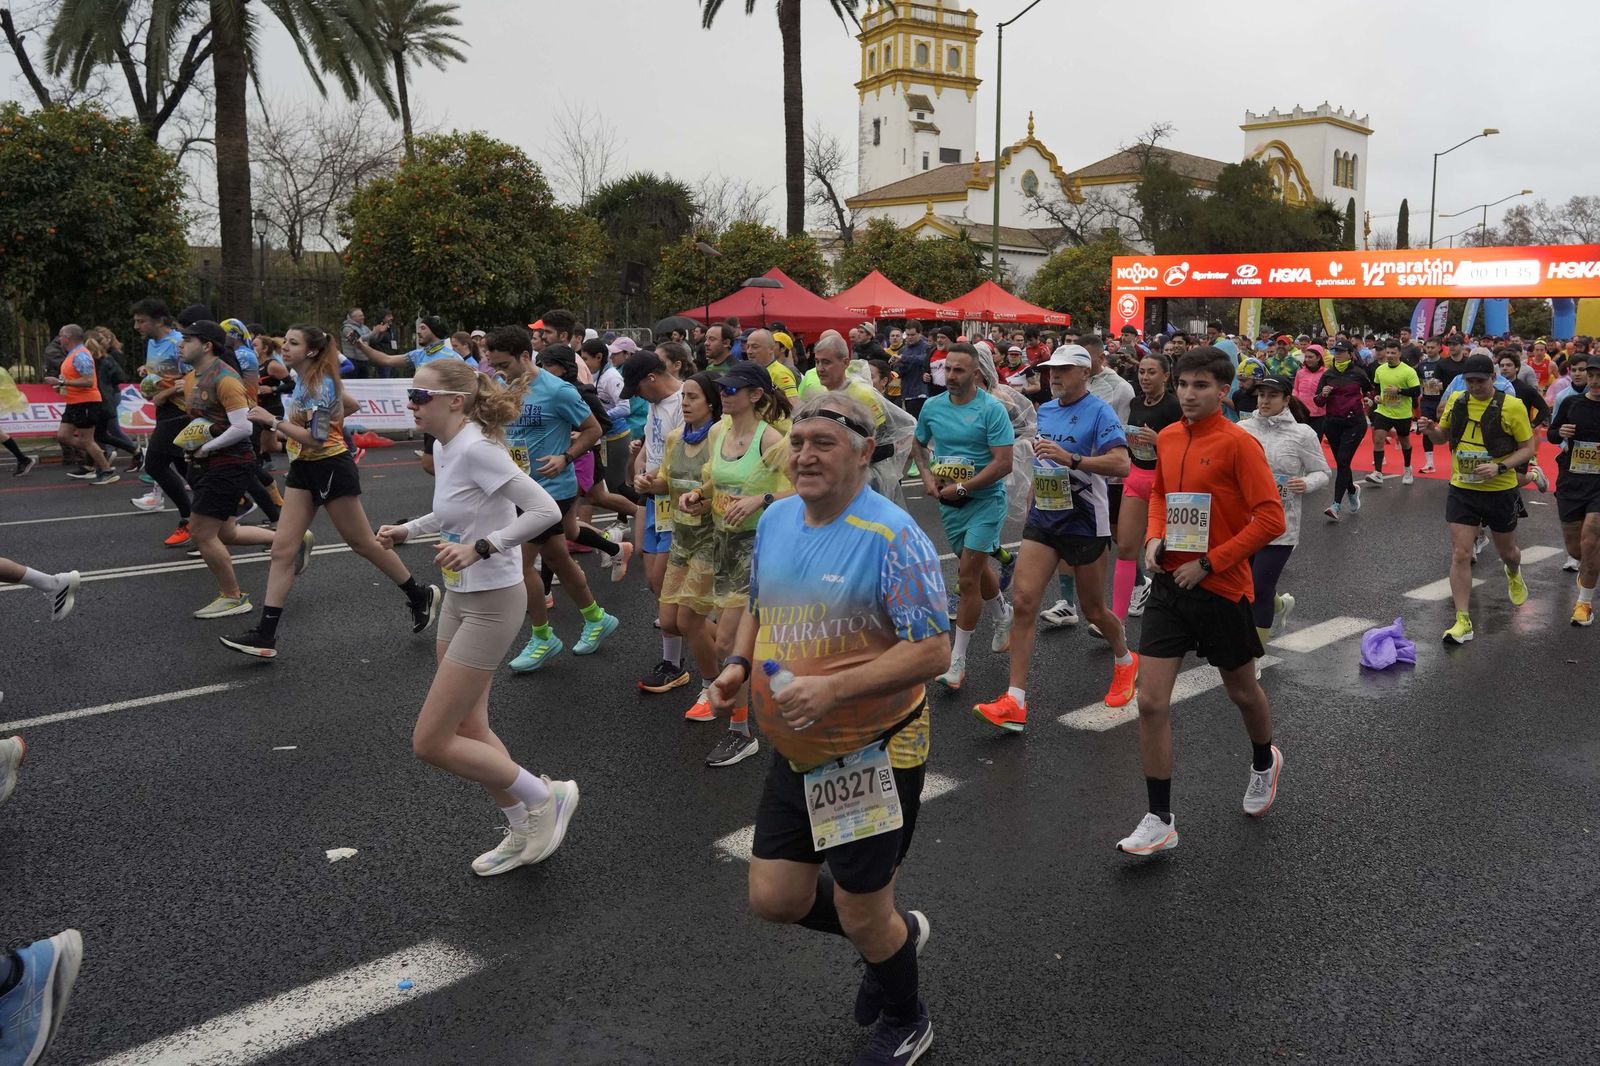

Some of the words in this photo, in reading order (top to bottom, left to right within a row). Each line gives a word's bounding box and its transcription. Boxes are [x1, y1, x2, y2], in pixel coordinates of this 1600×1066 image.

[1381, 258, 1453, 273] maratón
[1547, 261, 1600, 278] HOKA
[1191, 271, 1229, 280] Sprinter
[1268, 268, 1312, 282] HOKA
[1397, 270, 1456, 286] sevilla
[359, 400, 405, 414] EATE
[1167, 507, 1200, 525] 2808
[821, 573, 846, 584] HOKA
[760, 601, 828, 625] MEDIO
[770, 610, 883, 644] MARATÓN
[775, 630, 869, 661] SEVILLA
[811, 766, 876, 810] 20327
